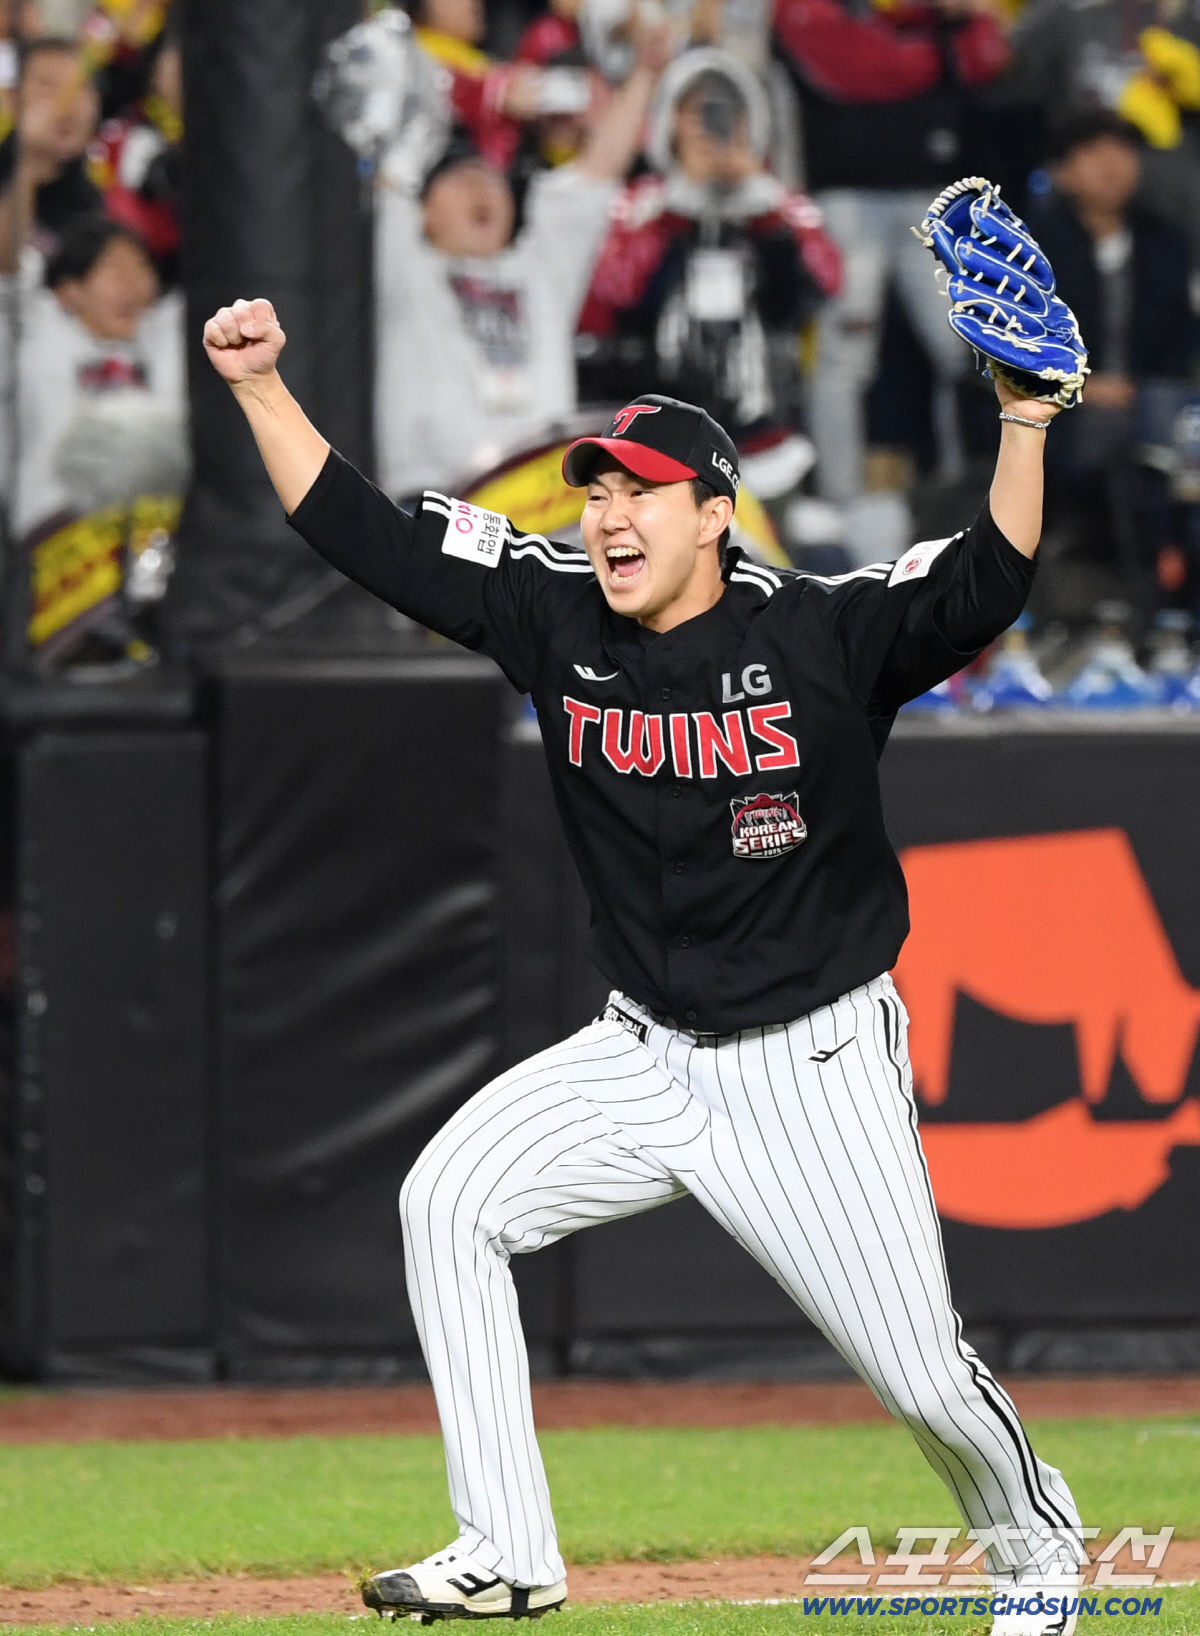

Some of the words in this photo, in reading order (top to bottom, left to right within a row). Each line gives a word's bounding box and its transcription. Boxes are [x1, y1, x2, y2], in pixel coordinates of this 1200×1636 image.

[477, 512, 501, 555] 통화앱
[722, 663, 773, 703] LG
[563, 695, 800, 779] TWINS
[734, 826, 806, 854] SERIES
[740, 820, 798, 838] KOREAN
